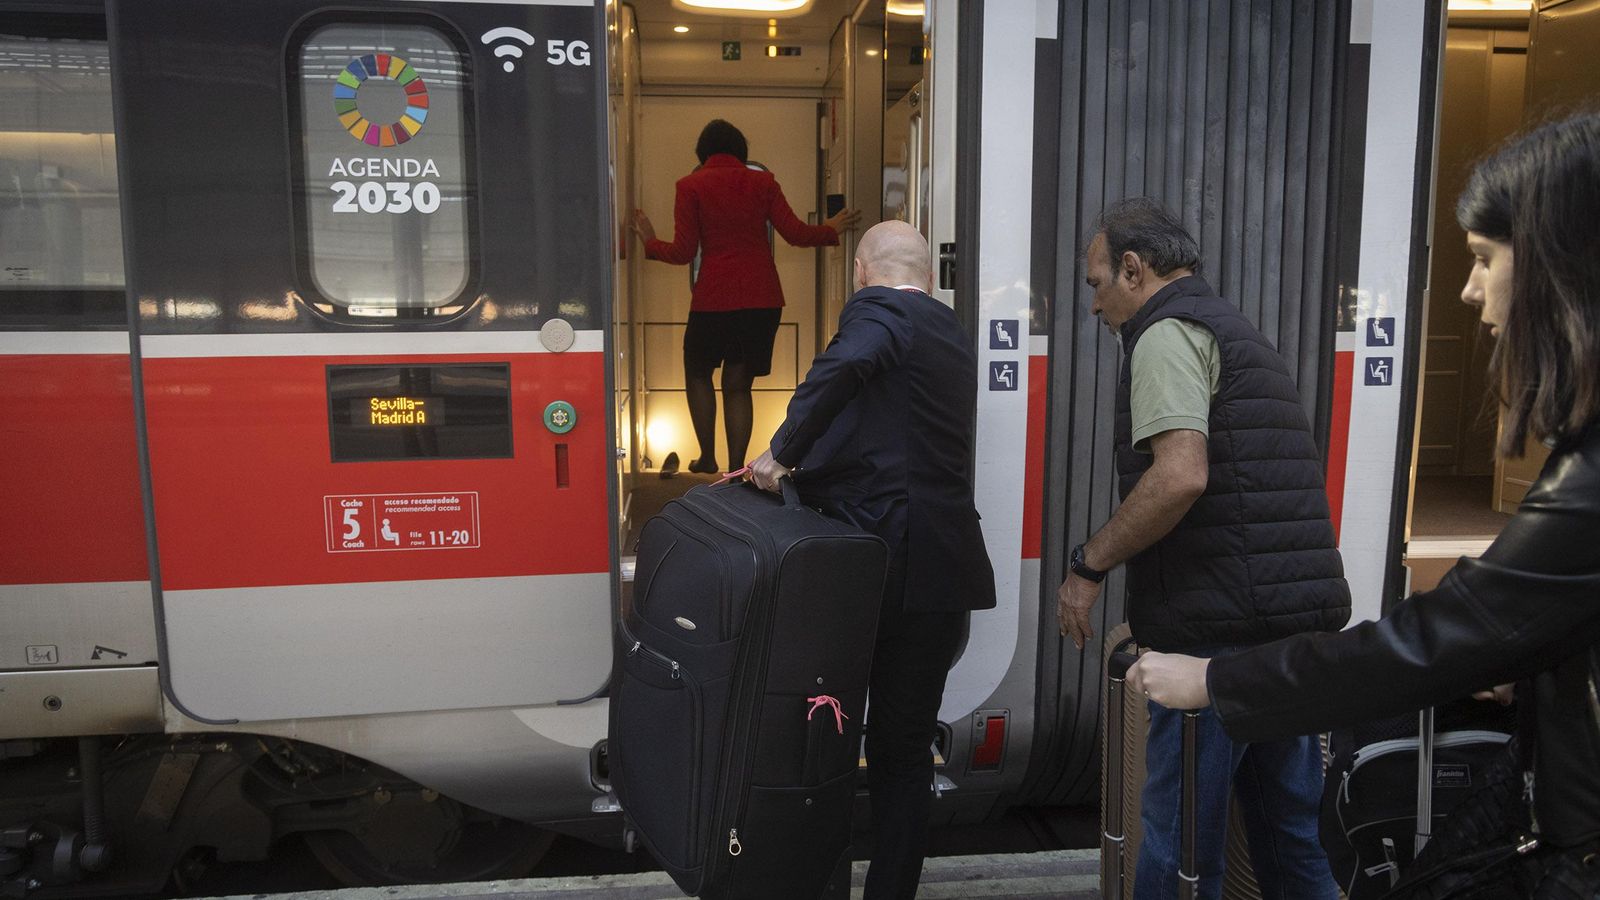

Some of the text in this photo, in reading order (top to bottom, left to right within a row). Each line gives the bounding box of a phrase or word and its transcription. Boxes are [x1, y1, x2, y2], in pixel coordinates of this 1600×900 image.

[547, 40, 591, 66] 5G
[328, 157, 440, 177] AGENDA
[330, 181, 441, 213] 2030
[372, 411, 425, 424] Madrid A
[341, 499, 363, 507] Coche
[410, 497, 460, 505] recomendado
[385, 505, 436, 513] recommended
[343, 509, 360, 540] 5
[343, 540, 365, 548] Coach
[429, 530, 469, 545] 11-20
